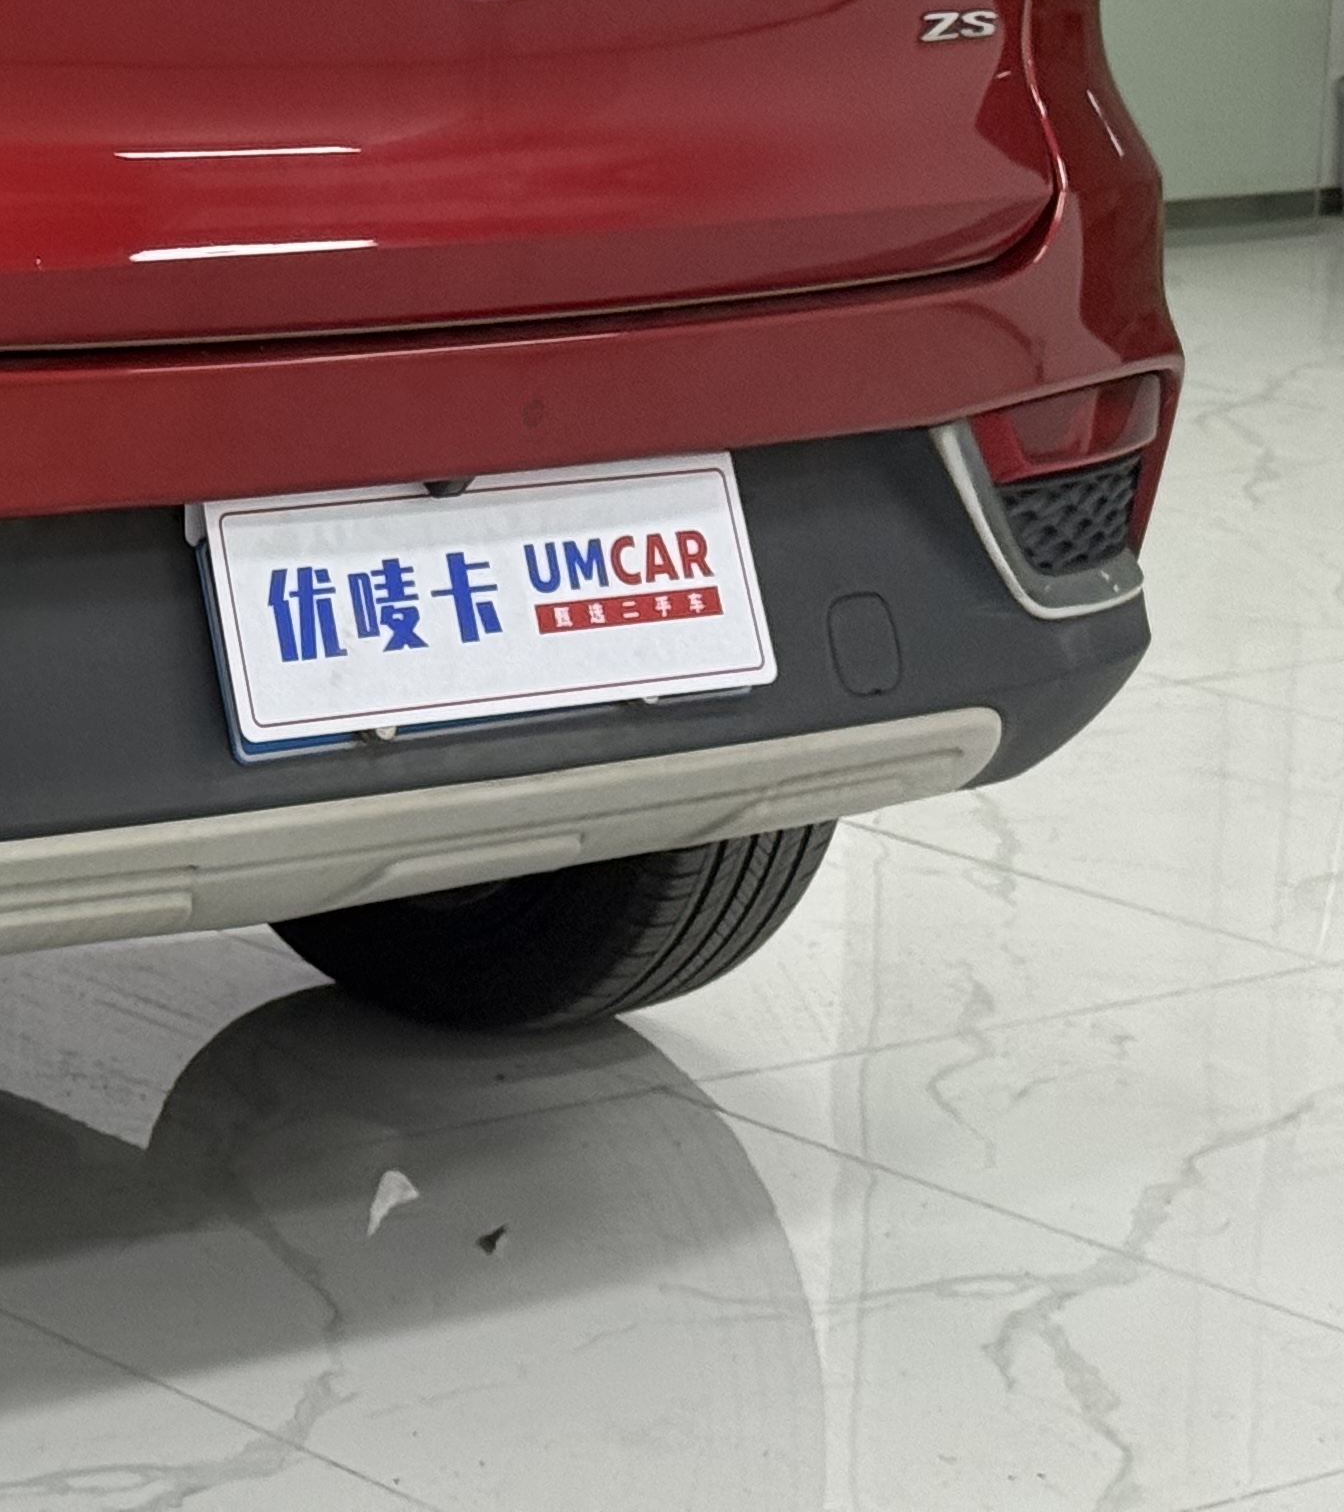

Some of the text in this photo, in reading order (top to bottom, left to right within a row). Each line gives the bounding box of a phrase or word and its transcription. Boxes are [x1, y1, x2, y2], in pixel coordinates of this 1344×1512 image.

[921, 10, 998, 42] ZS
[524, 530, 715, 593] UMCAR
[268, 551, 504, 662] 优唛卡
